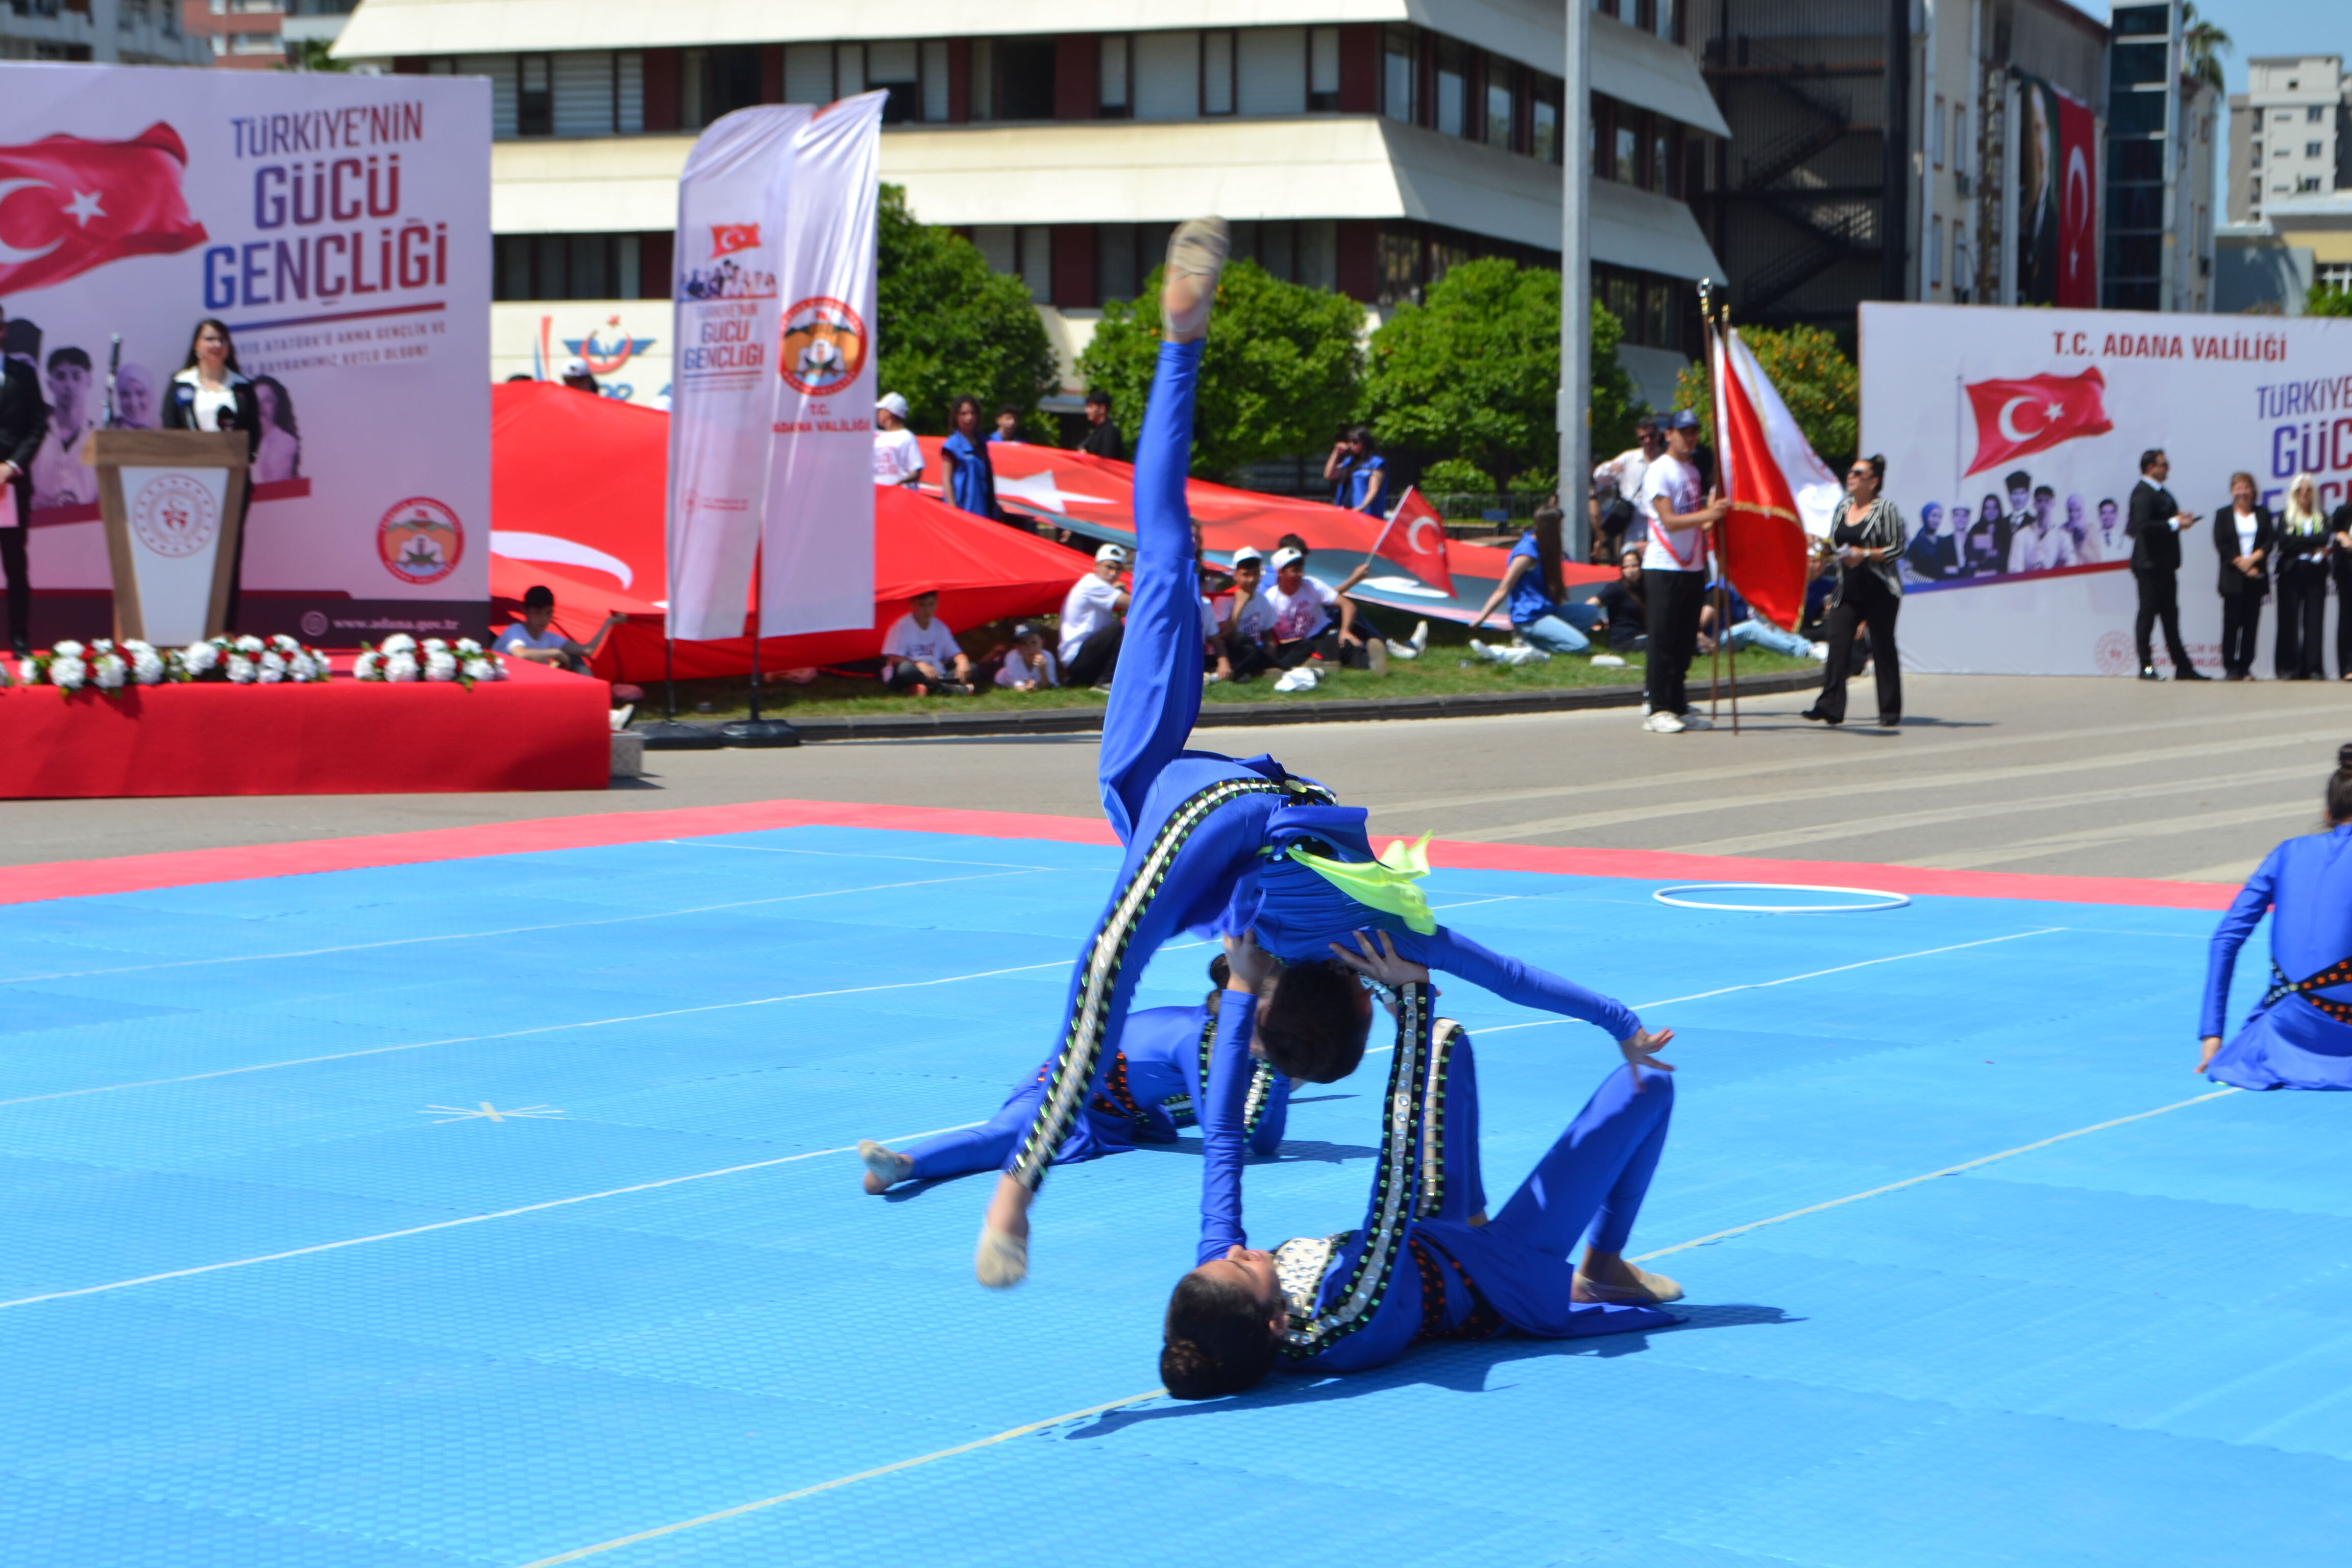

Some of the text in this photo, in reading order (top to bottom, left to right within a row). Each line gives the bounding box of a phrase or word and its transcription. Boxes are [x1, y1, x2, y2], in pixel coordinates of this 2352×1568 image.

[230, 101, 423, 159] TÜRKİYE'NİN
[254, 154, 400, 231] GÜCÜ
[205, 218, 447, 310] GENÇLİĞİ
[2052, 331, 2287, 362] T.C. ADANA VALİLİĞİ
